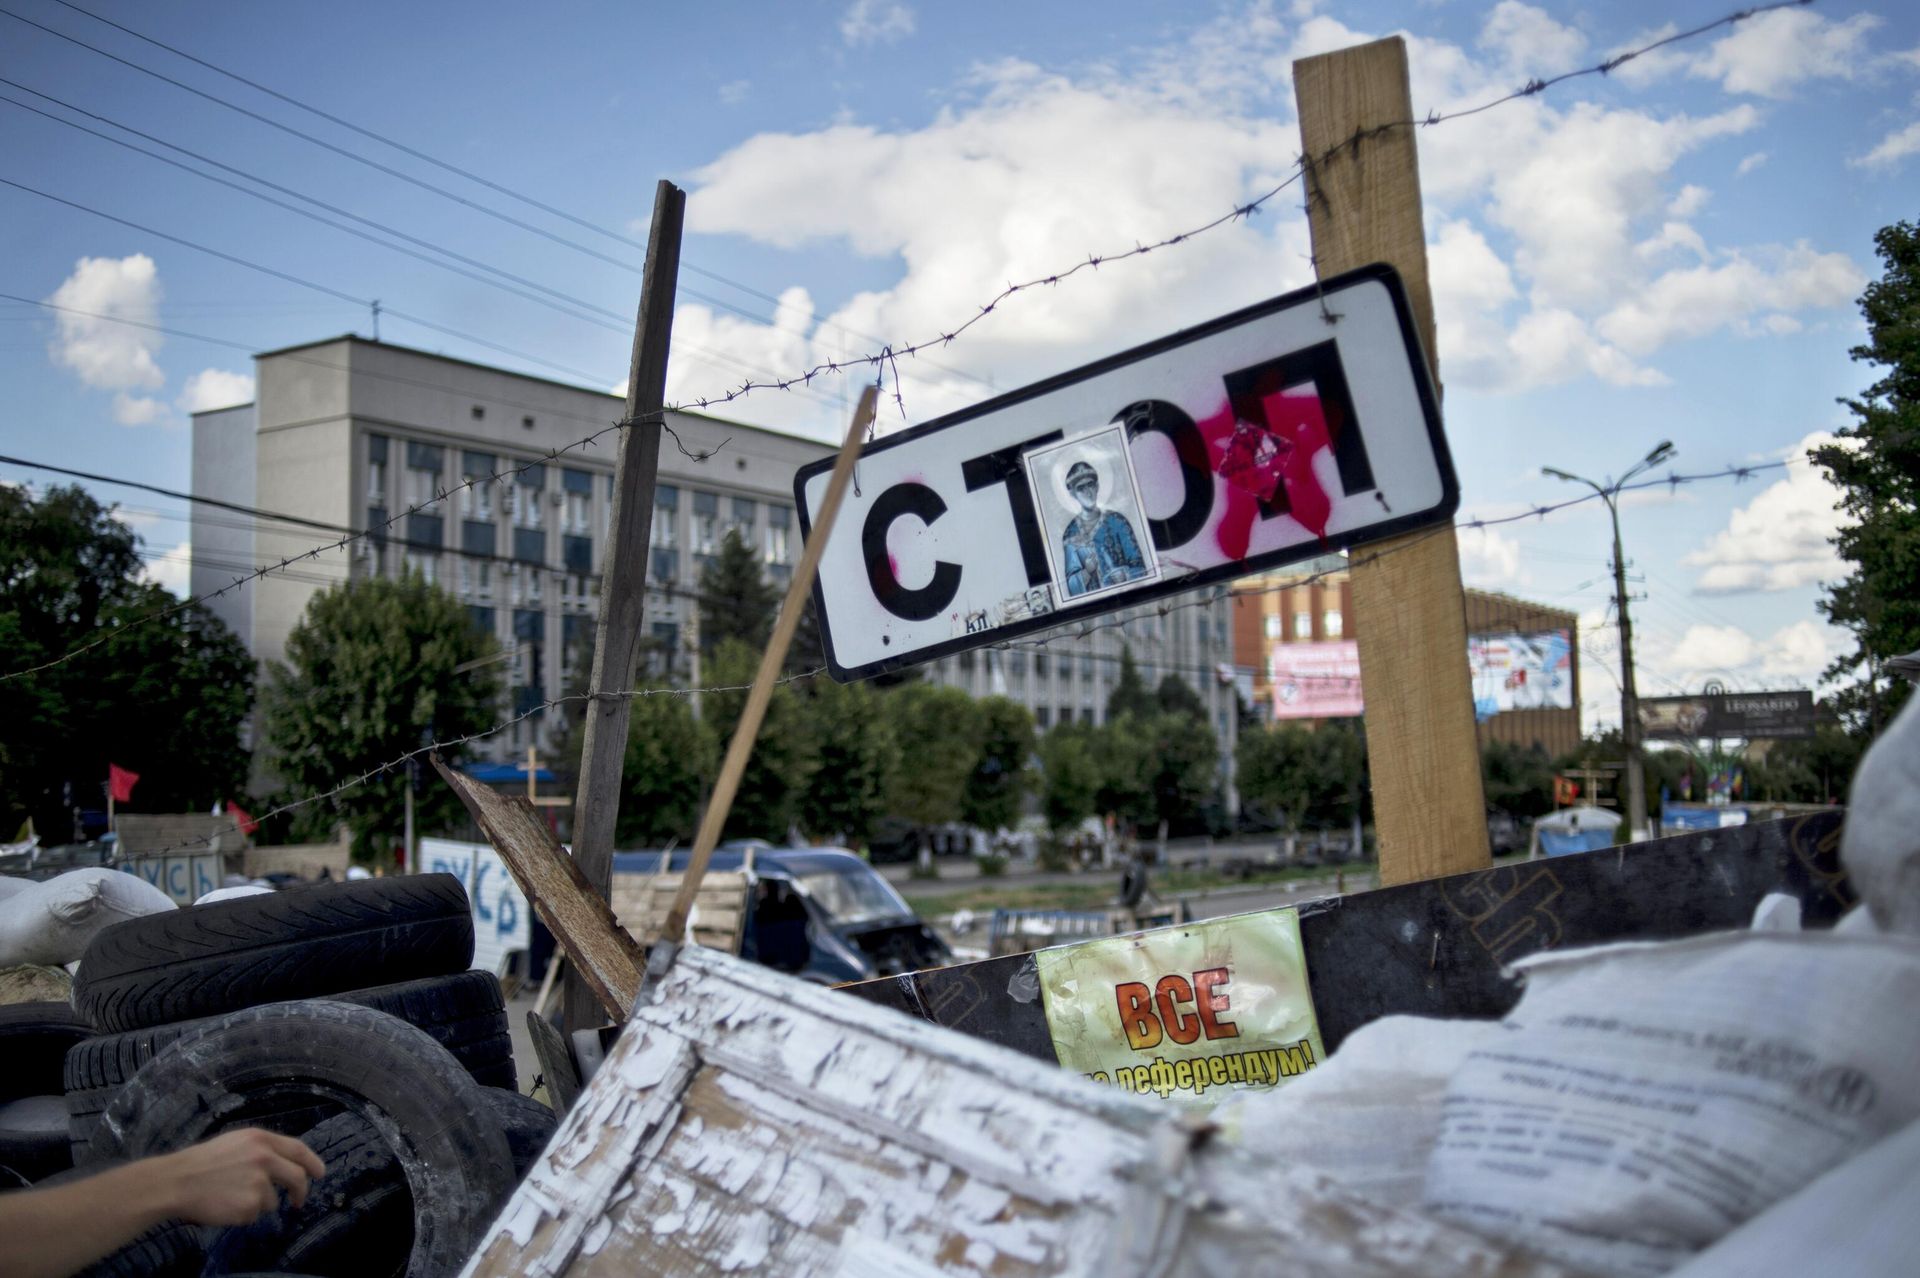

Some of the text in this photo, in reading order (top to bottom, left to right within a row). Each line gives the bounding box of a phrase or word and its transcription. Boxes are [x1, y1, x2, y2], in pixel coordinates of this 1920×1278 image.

[861, 338, 1376, 622] СТОП
[1115, 967, 1239, 1050] ВСЕ
[1117, 1040, 1317, 1098] референдум!
